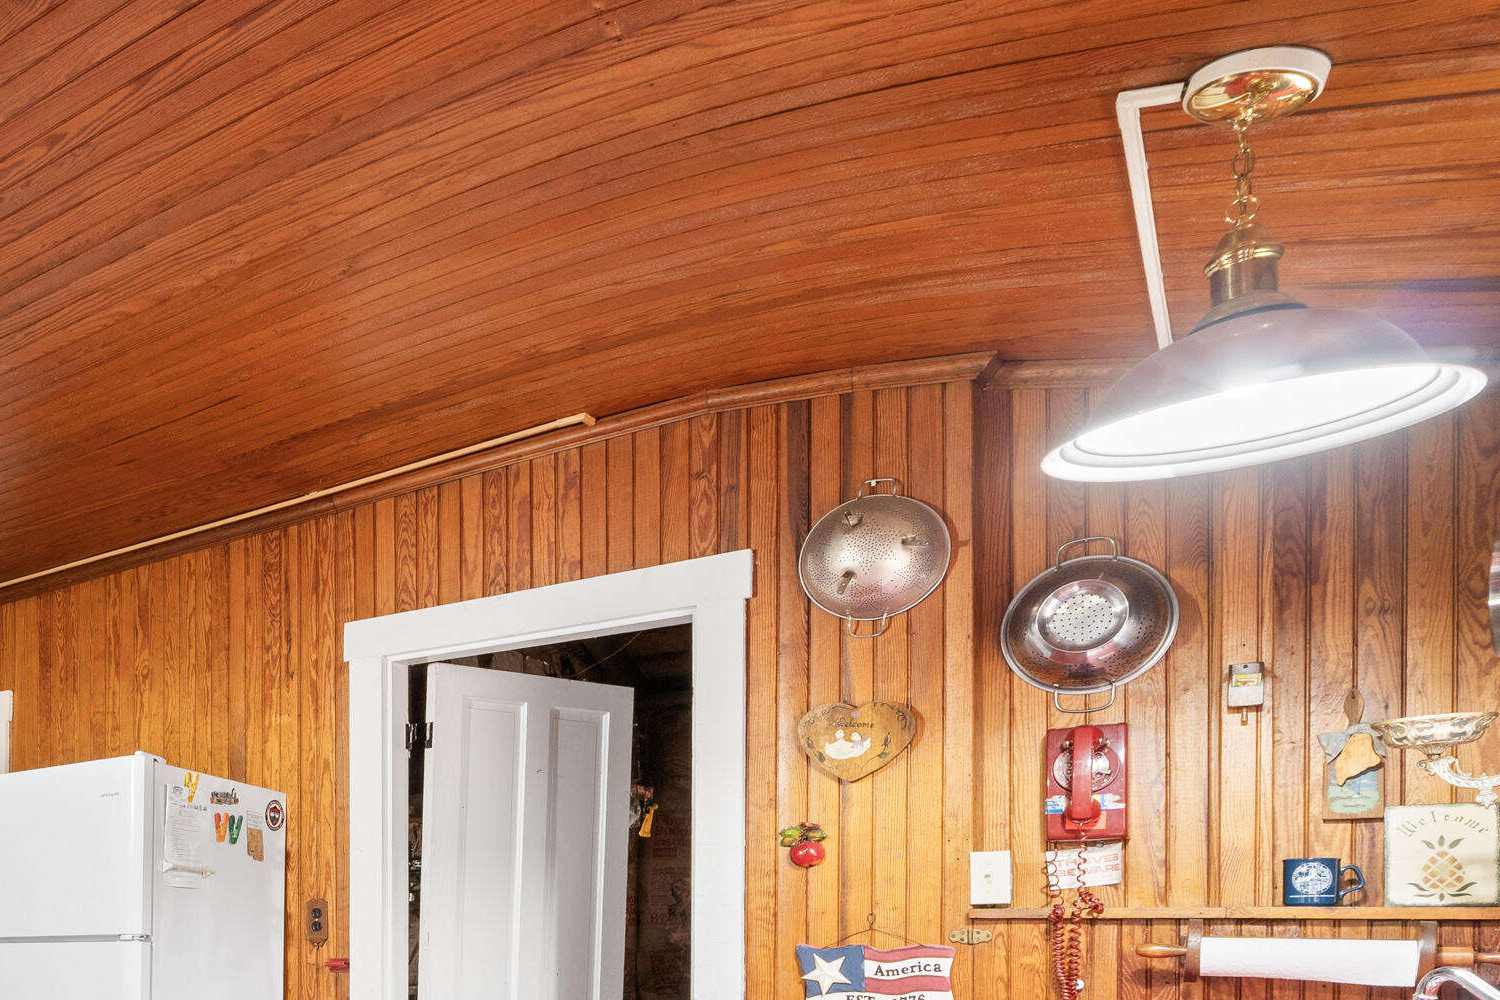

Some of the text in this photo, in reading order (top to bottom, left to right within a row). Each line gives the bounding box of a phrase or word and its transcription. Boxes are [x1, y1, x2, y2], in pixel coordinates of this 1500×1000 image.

[835, 716, 875, 729] Welcome
[1055, 853, 1119, 869] THVES
[874, 961, 942, 977] America
